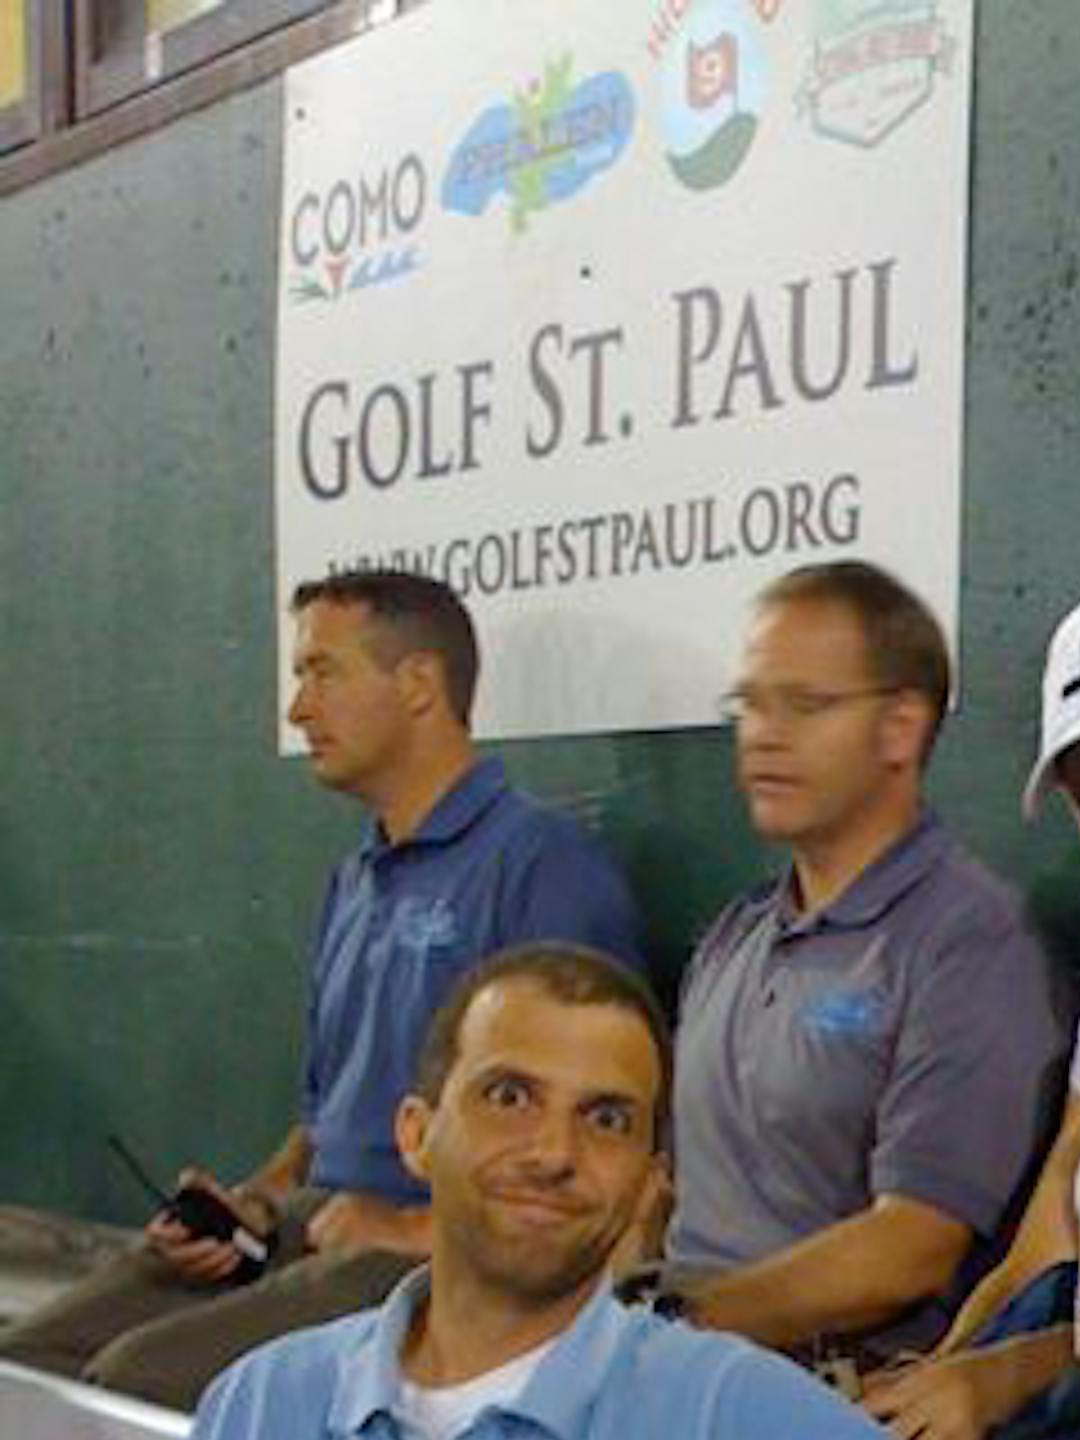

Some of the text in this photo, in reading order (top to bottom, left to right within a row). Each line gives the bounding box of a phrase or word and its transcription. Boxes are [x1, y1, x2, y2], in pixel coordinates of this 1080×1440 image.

[701, 50, 722, 96] 9
[290, 153, 427, 268] COMO
[299, 258, 919, 501] GOLF ST. PAUL
[326, 474, 862, 598] WGOLFSTPAUL.ORG
